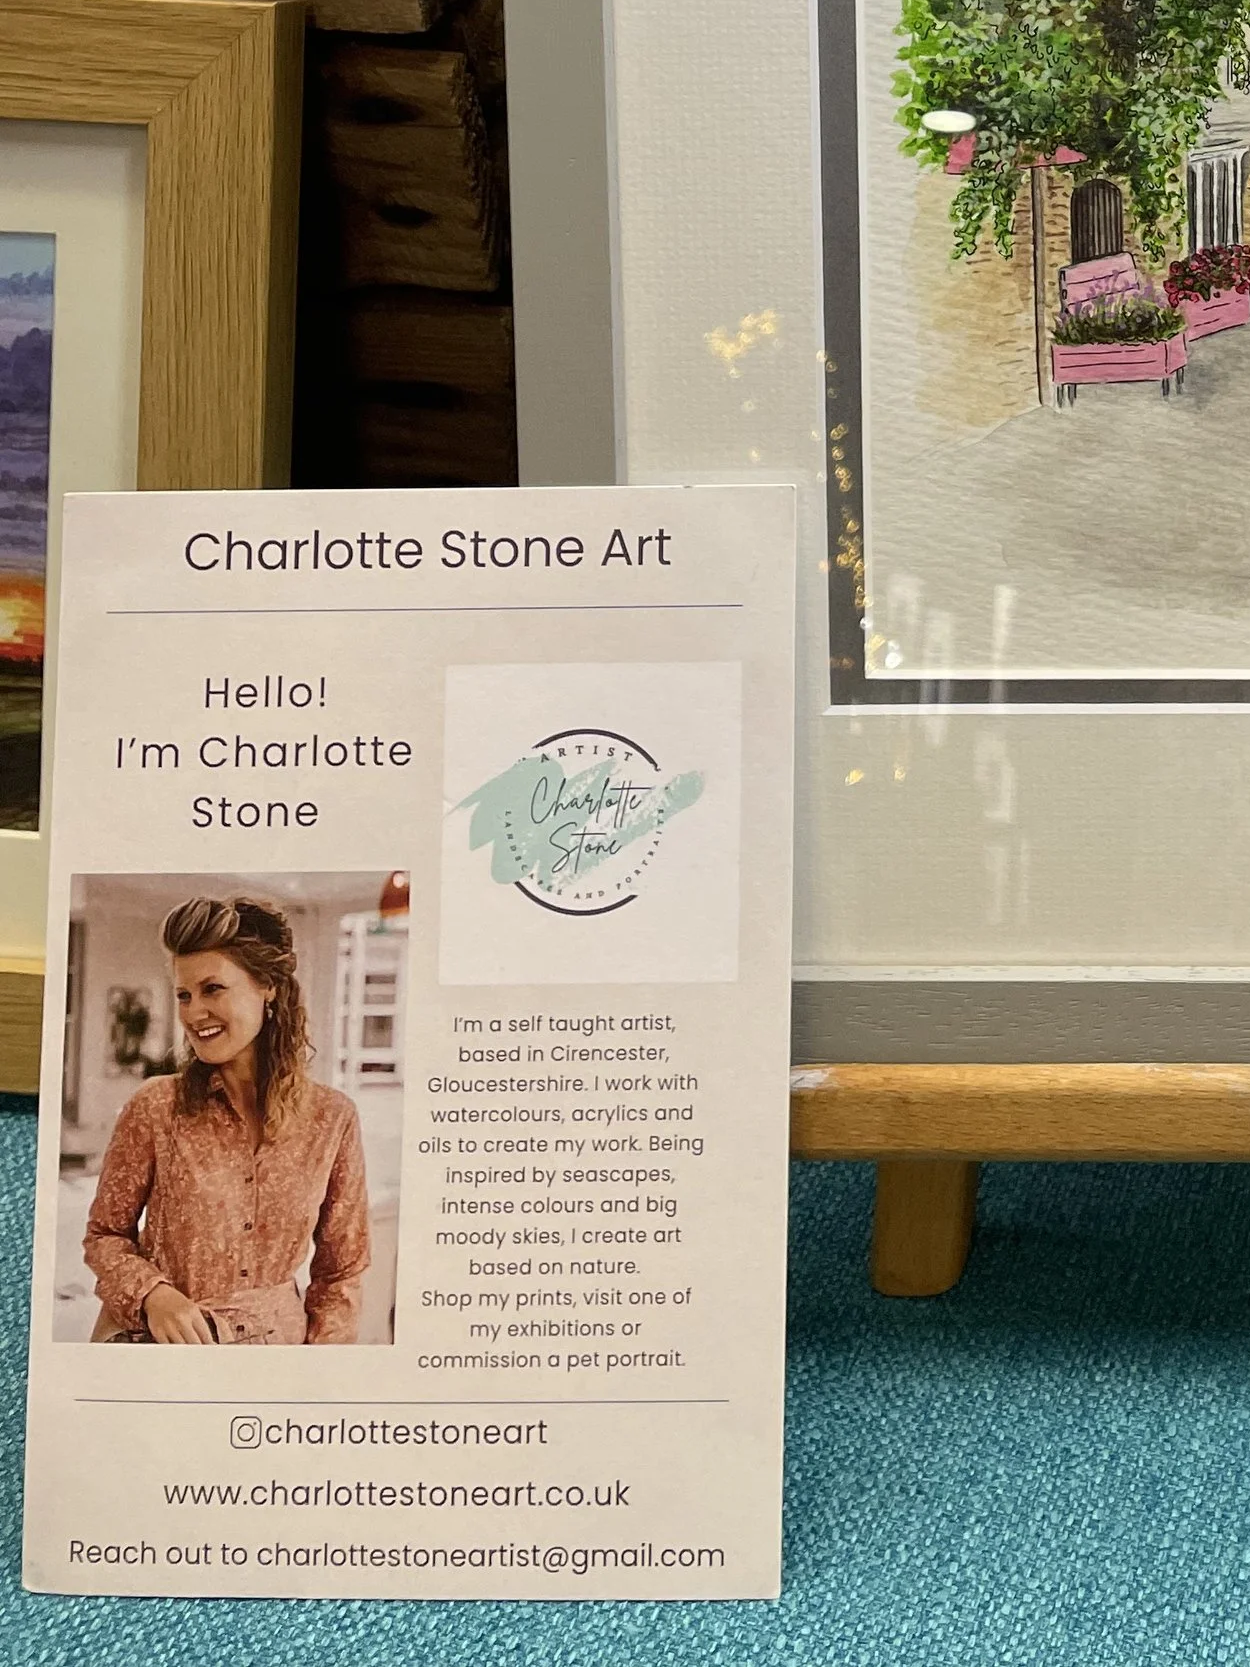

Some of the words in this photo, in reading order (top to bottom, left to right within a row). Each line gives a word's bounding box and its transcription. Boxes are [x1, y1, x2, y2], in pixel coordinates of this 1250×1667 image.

[184, 529, 424, 572] Charlotte
[440, 529, 585, 569] Stone
[600, 528, 672, 567] Art
[204, 674, 326, 709] Hello!
[116, 737, 180, 769] I'm
[199, 733, 412, 769] Charlotte
[539, 744, 634, 764] ARTIST
[191, 796, 319, 829] Stone
[530, 775, 655, 829] Charlotte
[548, 821, 623, 874] Stone
[453, 1016, 484, 1034] I'm
[488, 1019, 502, 1033] a
[507, 1014, 544, 1033] self
[548, 1014, 616, 1038] taught
[620, 1013, 677, 1034] artist,
[458, 1045, 522, 1063] based
[527, 1044, 545, 1063] in
[550, 1044, 670, 1064] Cirencester,
[427, 1074, 589, 1094] Gloucestershire.
[594, 1074, 599, 1092] I
[604, 1073, 653, 1093] work
[656, 1073, 699, 1091] with
[429, 1105, 566, 1125] watercolours,
[571, 1103, 649, 1128] acrylics
[654, 1103, 694, 1122] and
[418, 1135, 452, 1154] oils
[457, 1137, 478, 1154] to
[482, 1136, 549, 1154] create
[554, 1138, 587, 1159] my
[591, 1134, 644, 1153] work.
[648, 1133, 705, 1157] Being
[445, 1165, 526, 1190] inspired
[531, 1165, 557, 1189] by
[562, 1168, 676, 1188] seascapes,
[441, 1196, 515, 1215] intense
[520, 1196, 595, 1215] colours
[599, 1195, 640, 1214] and
[645, 1194, 678, 1218] big
[435, 1227, 507, 1251] moody
[511, 1226, 566, 1247] skies,
[570, 1227, 576, 1245] I
[581, 1226, 648, 1244] create
[652, 1226, 683, 1244] art
[468, 1257, 532, 1276] based
[538, 1261, 564, 1276] on
[569, 1258, 641, 1276] nature.
[421, 1289, 473, 1313] Shop
[478, 1292, 511, 1312] my
[515, 1288, 577, 1312] prints,
[582, 1287, 624, 1306] visit
[628, 1291, 667, 1306] one
[672, 1286, 693, 1305] of
[469, 1323, 503, 1345] my
[507, 1318, 616, 1338] exhibitions
[620, 1322, 643, 1337] or
[417, 1349, 542, 1369] commission
[547, 1354, 561, 1368] a
[566, 1351, 601, 1374] pet
[606, 1348, 687, 1373] portrait.
[264, 1417, 548, 1445] charlottestoneart
[163, 1478, 632, 1507] www.charlottestoneart.co.uk
[69, 1539, 157, 1565] Reach
[165, 1542, 213, 1566] out
[220, 1542, 248, 1566] to
[256, 1541, 725, 1576] charlottestoneartist@gmail.com
